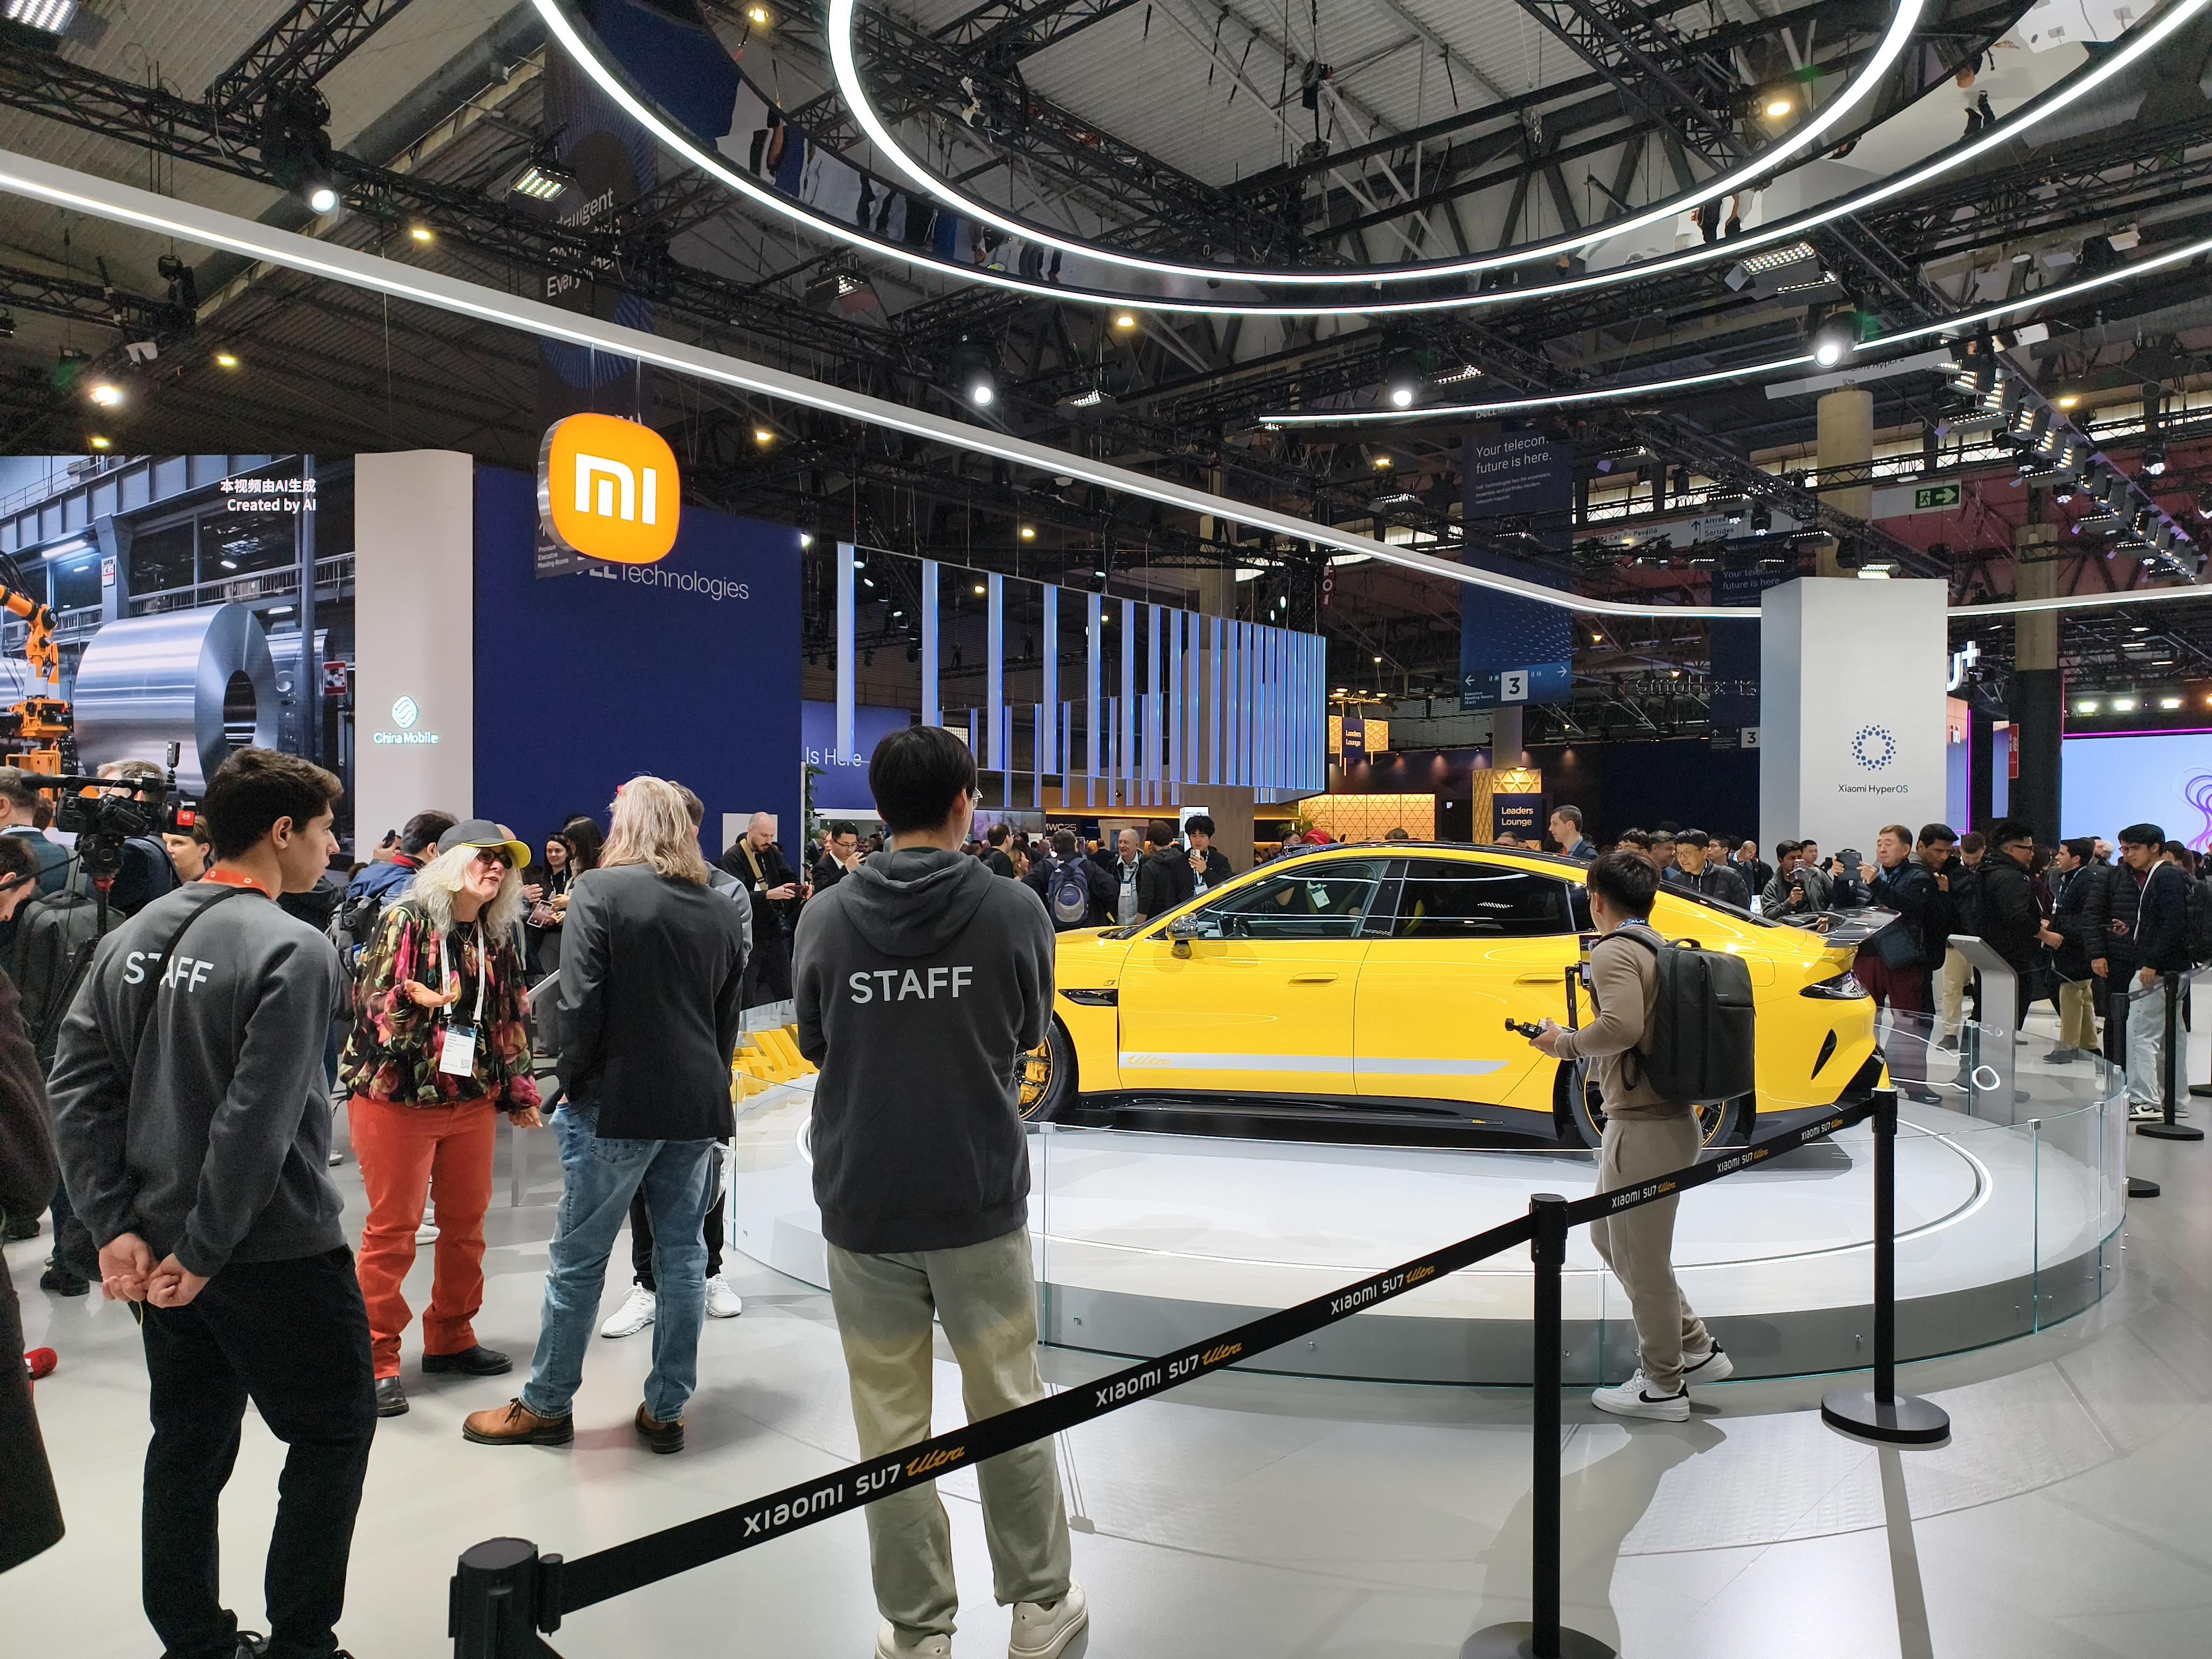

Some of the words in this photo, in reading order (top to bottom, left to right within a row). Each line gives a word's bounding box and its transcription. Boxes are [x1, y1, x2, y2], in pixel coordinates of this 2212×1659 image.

[1476, 443, 1501, 458] Your
[1476, 460, 1509, 474] future
[1512, 456, 1521, 467] is
[1524, 451, 1552, 464] here.
[220, 478, 316, 493] 本视频由AI生成
[227, 498, 280, 511] Created
[284, 498, 300, 514] by
[303, 499, 316, 511] AI
[1723, 582, 1749, 590] future
[1509, 677, 1520, 694] 3
[373, 731, 403, 744] China
[403, 731, 439, 744] Mobile
[1346, 729, 1361, 737] Leaders
[1748, 732, 1756, 744] 3
[1346, 738, 1361, 747] Lounge
[806, 746, 819, 765] Is
[825, 747, 862, 766] He
[1838, 784, 1866, 792] Xiaomi
[1869, 785, 1908, 795] HyperOS
[1501, 806, 1534, 814] Leaders
[1501, 817, 1532, 827] Lounge
[849, 966, 973, 1004] STAFF
[1127, 1055, 1172, 1065] Ultra
[1821, 1122, 1831, 1132] SU7
[1742, 1152, 1753, 1164] SU7
[1643, 1185, 1657, 1198] SU7
[1658, 1181, 1676, 1193] Ultra
[1382, 1273, 1404, 1293] SU7
[1406, 1265, 1434, 1284] Ultra
[1169, 1354, 1199, 1379] SU7
[1203, 1341, 1242, 1366] Ultra
[856, 1464, 900, 1496] SU7
[906, 1446, 965, 1476] Ultra
